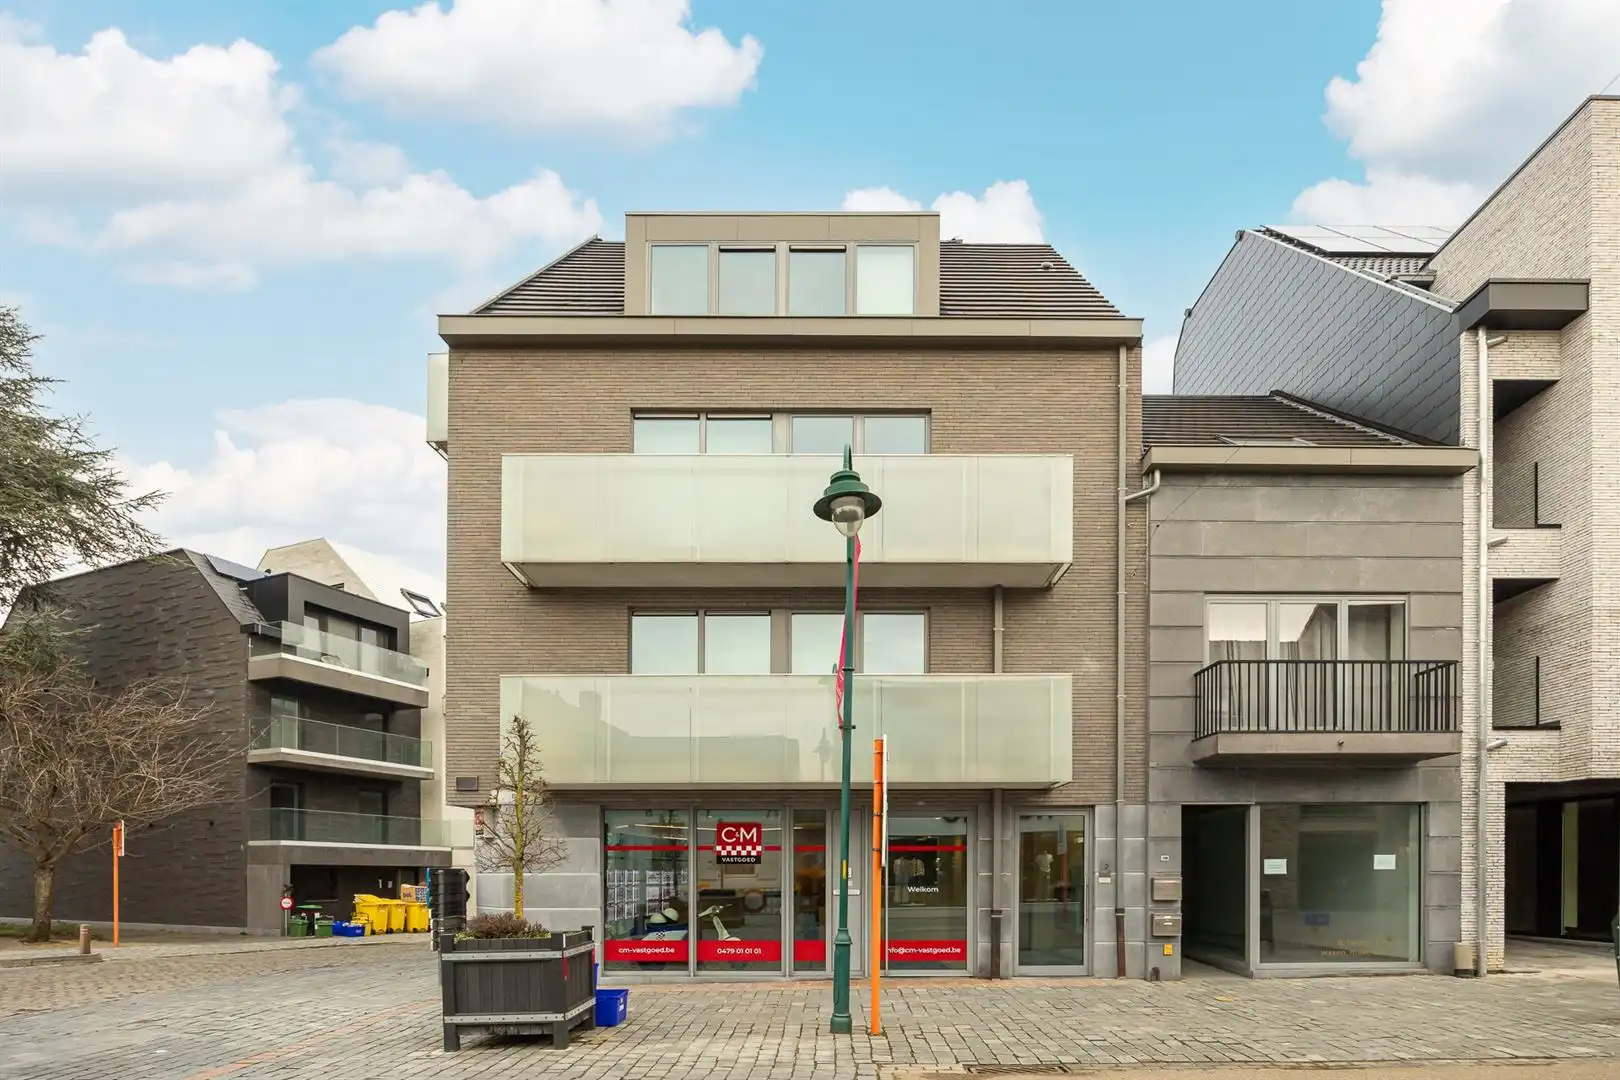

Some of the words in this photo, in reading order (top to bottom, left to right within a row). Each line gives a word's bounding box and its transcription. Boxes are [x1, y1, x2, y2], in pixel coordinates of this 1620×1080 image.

[721, 827, 757, 843] C&M
[907, 885, 939, 893] Welkom
[618, 947, 675, 955] cm-vastgoed.be
[716, 947, 735, 955] 0479
[736, 947, 744, 955] 01
[744, 947, 753, 955] 01
[753, 947, 762, 955] 01
[887, 946, 961, 956] nfo@cm-vastgoed.be
